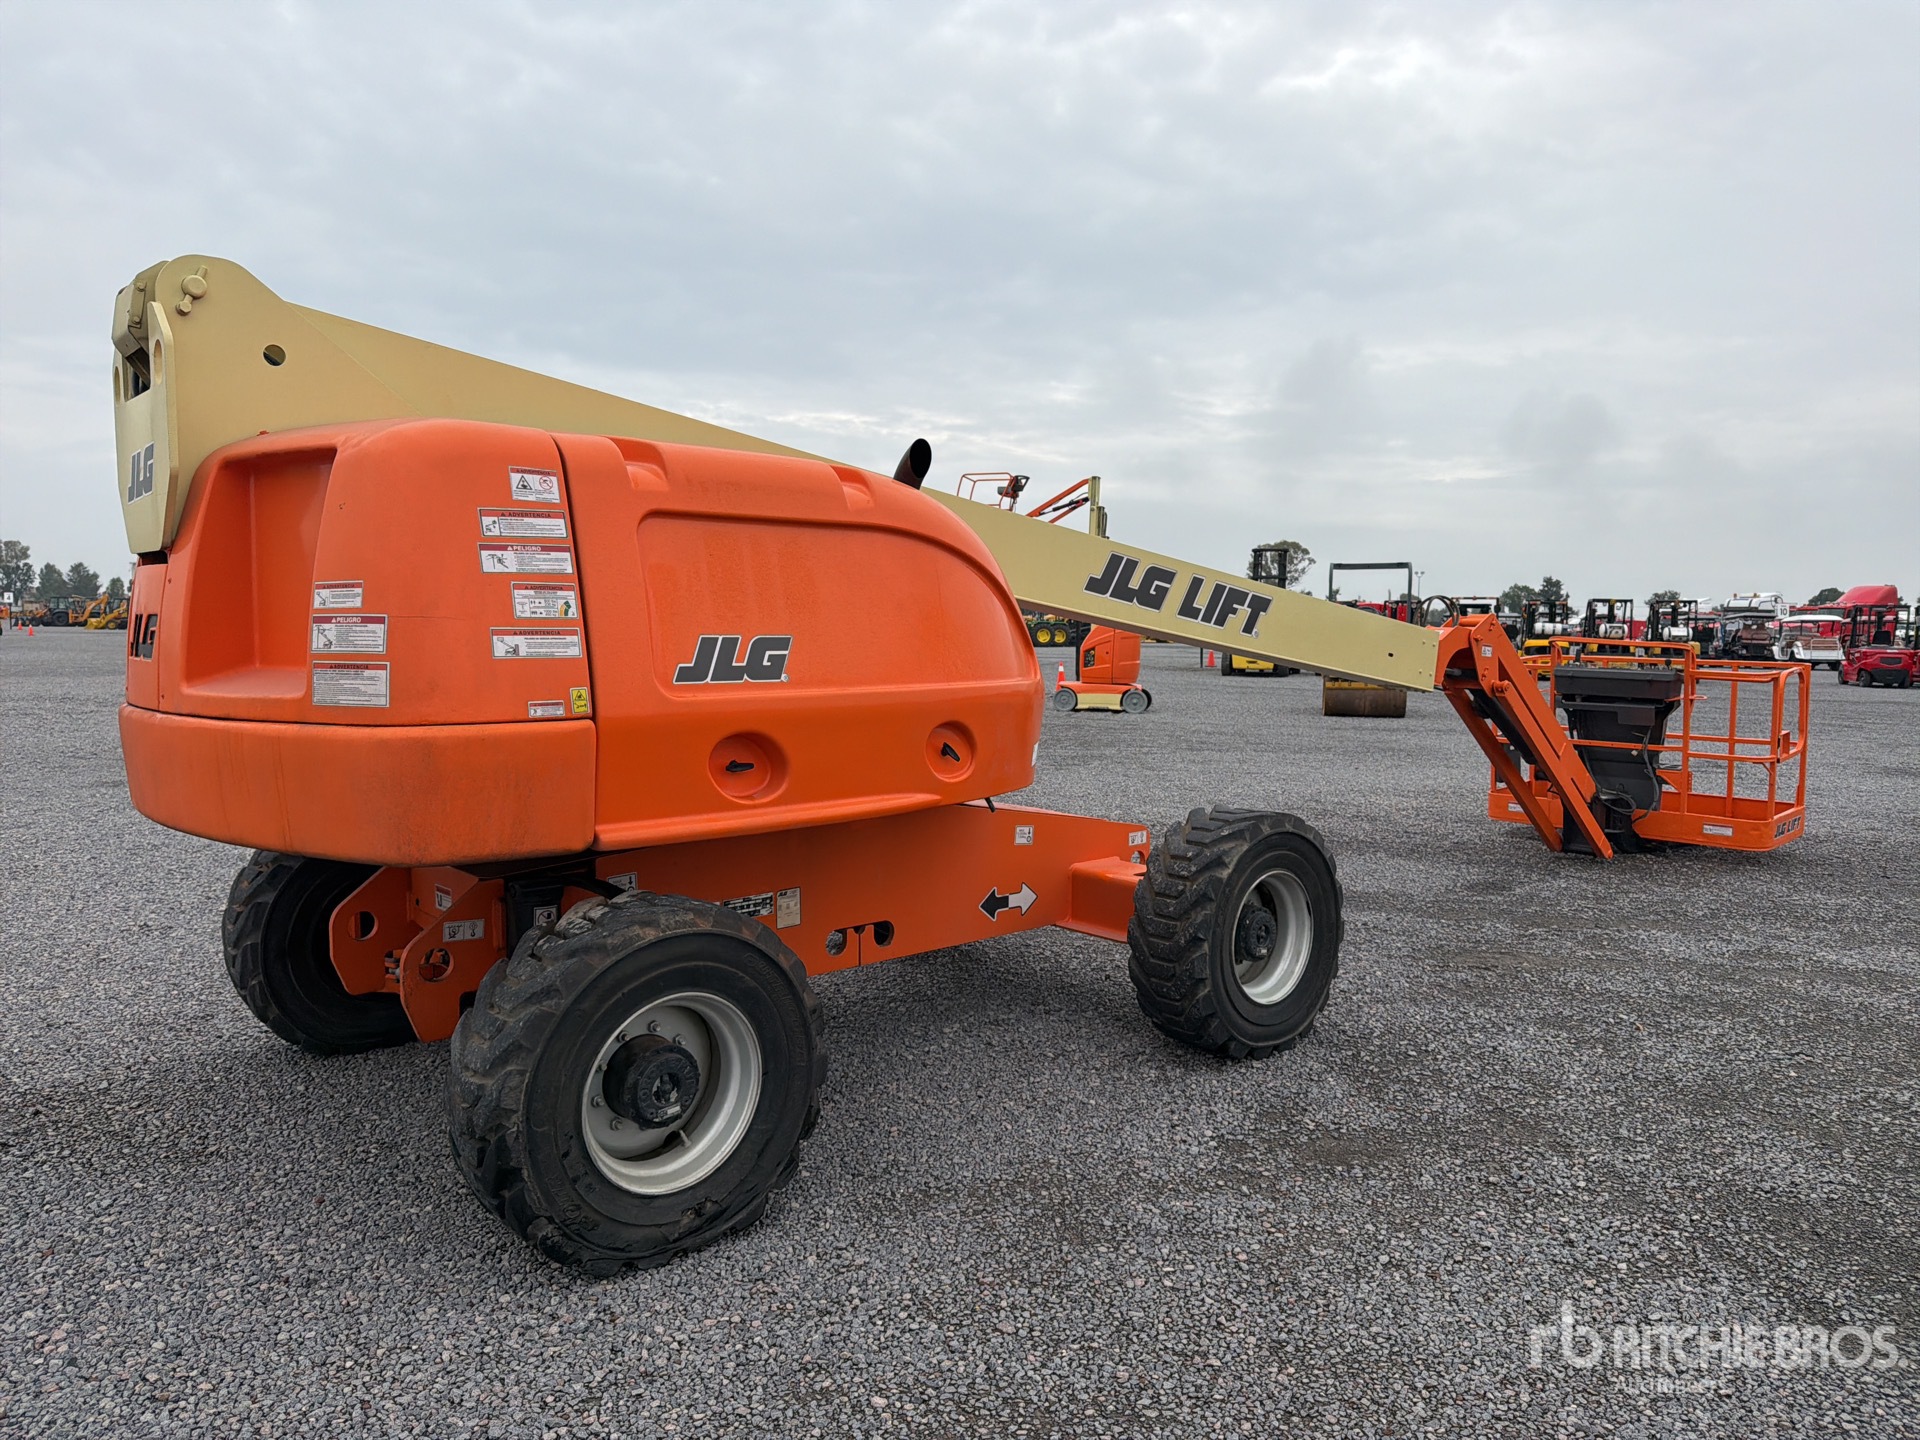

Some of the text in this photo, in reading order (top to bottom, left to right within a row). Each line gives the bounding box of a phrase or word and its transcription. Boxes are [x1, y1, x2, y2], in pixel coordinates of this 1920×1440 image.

[127, 441, 154, 505] JLG
[1082, 551, 1273, 638] JLG LIFT
[1780, 607, 1787, 616] 10
[129, 613, 158, 662] JLG
[673, 634, 793, 684] JLG
[1774, 816, 1801, 839] JLG LIFT
